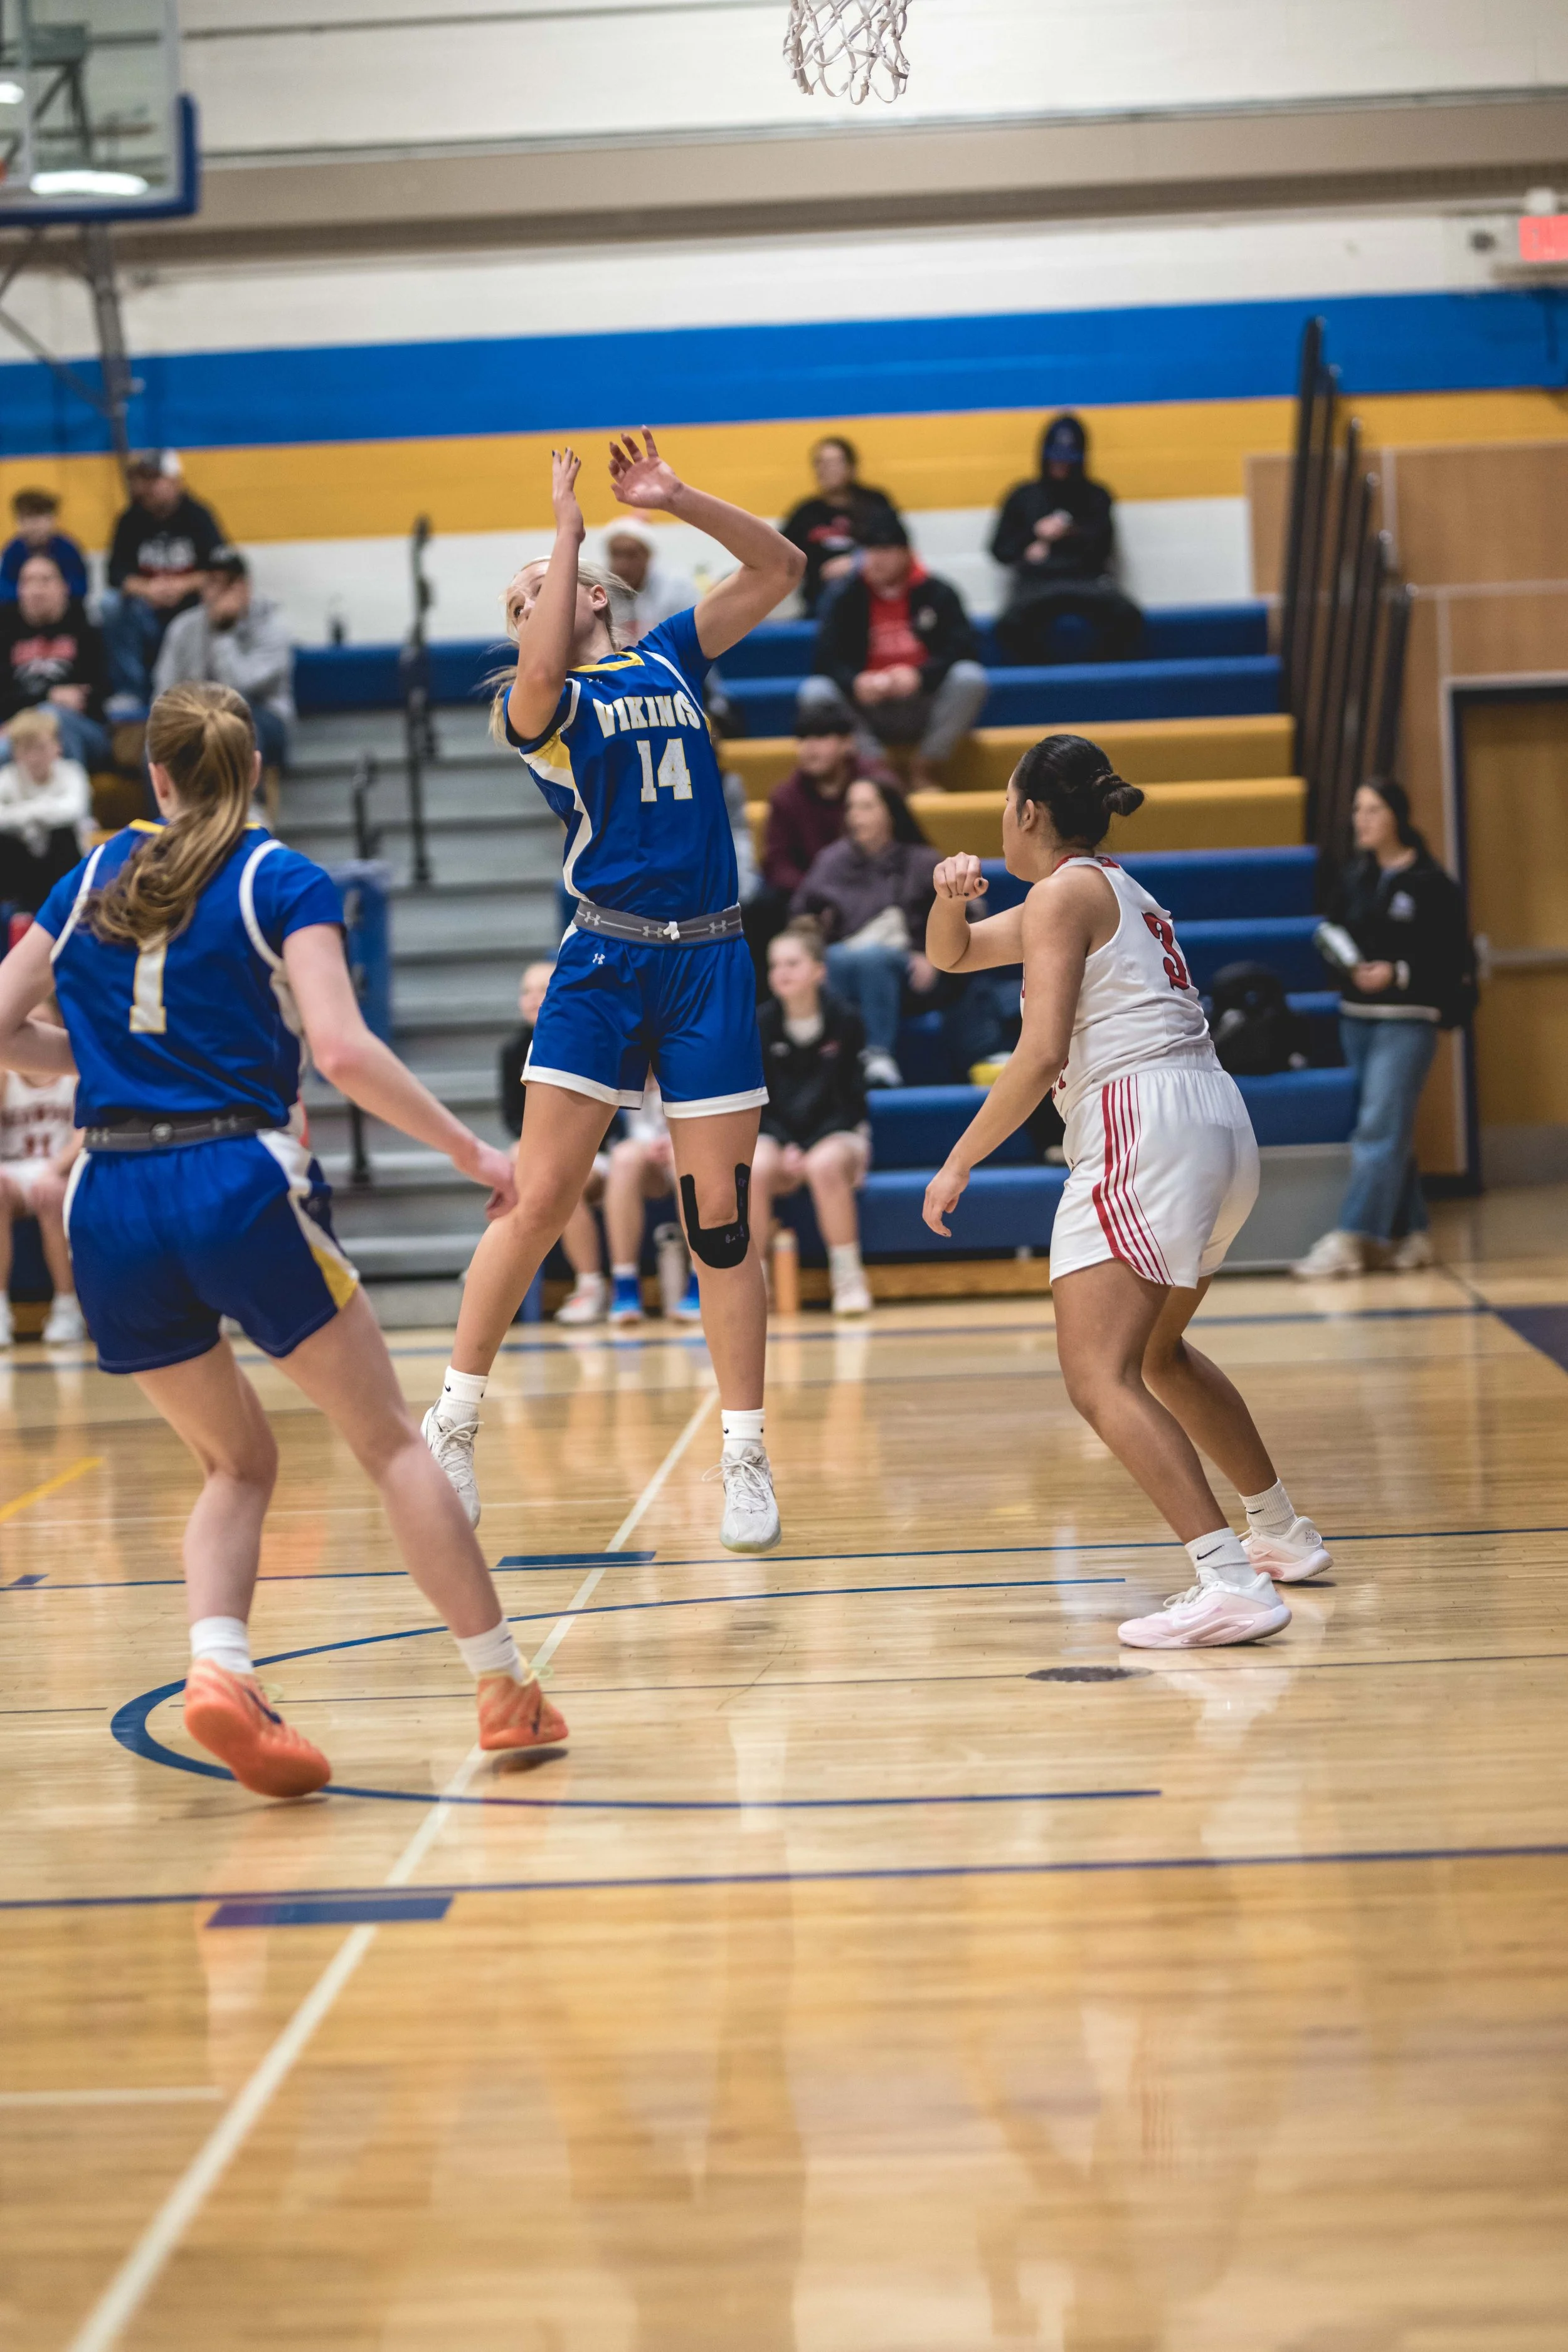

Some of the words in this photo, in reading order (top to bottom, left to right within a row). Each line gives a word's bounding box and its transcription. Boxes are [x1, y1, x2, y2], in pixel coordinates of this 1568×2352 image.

[592, 690, 701, 739] VIKINGS
[636, 738, 693, 802] 14
[129, 928, 167, 1034] 1
